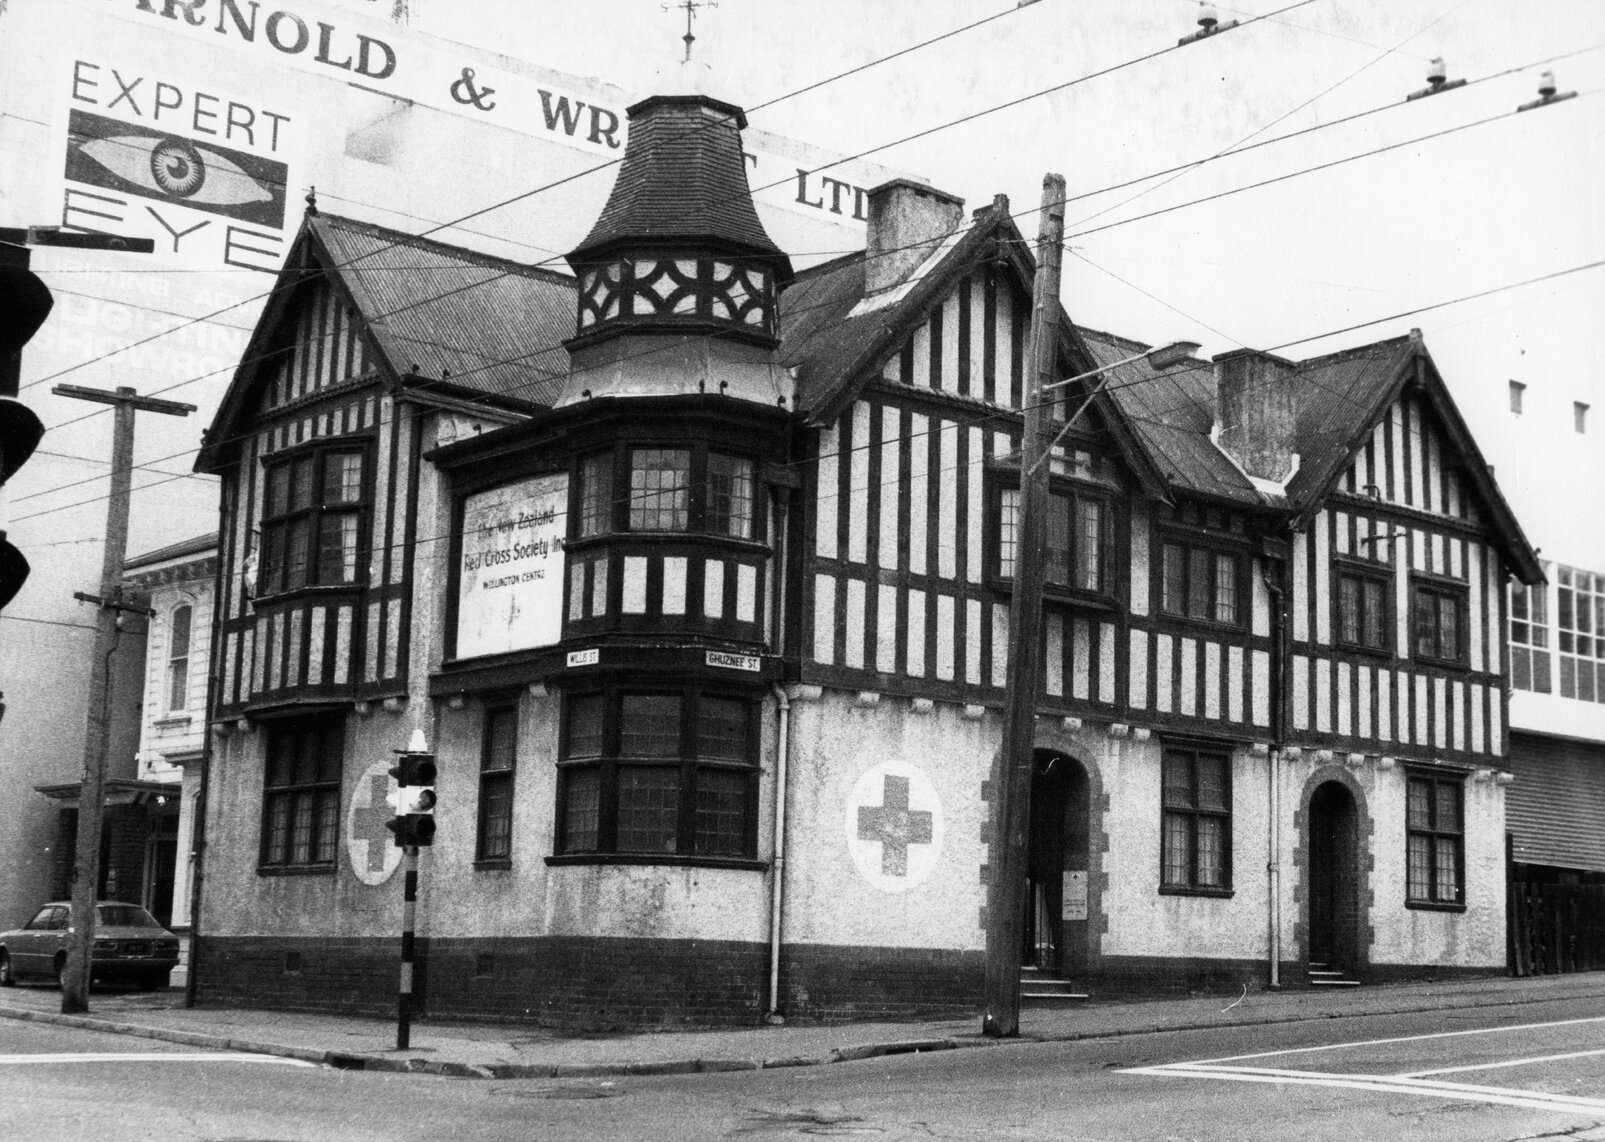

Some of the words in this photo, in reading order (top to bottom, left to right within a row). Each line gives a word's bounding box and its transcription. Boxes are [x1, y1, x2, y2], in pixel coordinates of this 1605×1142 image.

[135, 0, 397, 80] RNOLD
[450, 67, 496, 112] &
[71, 60, 291, 152] EXPERT
[62, 188, 284, 276] EYE
[518, 505, 555, 530] Zealand
[464, 551, 481, 572] Red
[485, 549, 511, 567] Cross
[513, 538, 549, 559] Society
[482, 574, 520, 590] WELLINGTON
[522, 569, 545, 583] CENTRE
[570, 652, 588, 664] WILLIS
[709, 653, 745, 668] GHUZNEE
